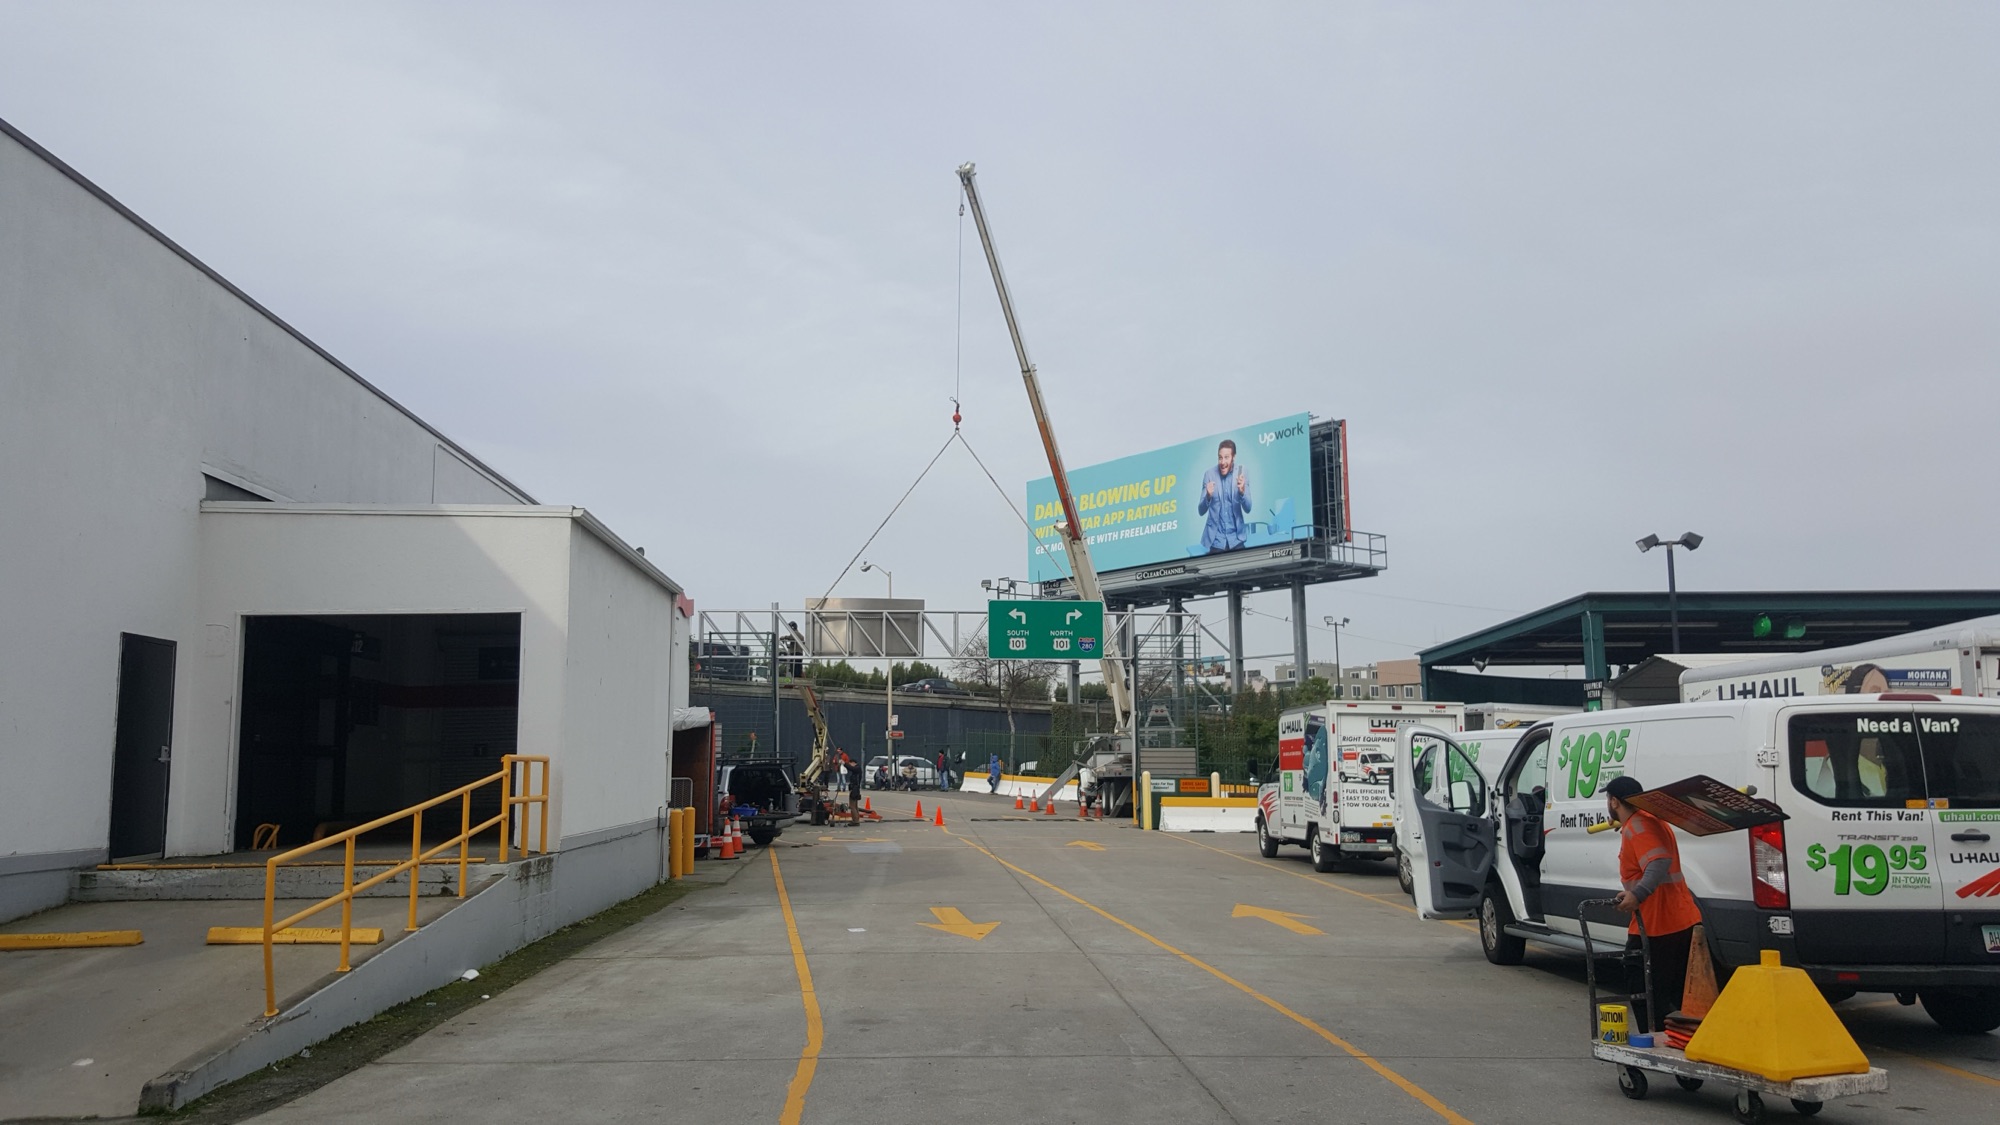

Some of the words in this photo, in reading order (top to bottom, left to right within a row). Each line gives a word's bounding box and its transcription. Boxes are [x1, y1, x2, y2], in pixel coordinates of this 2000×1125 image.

[1035, 497, 1075, 521] DAN
[1080, 480, 1150, 511] BLOWING
[1154, 474, 1176, 495] UP
[1035, 523, 1058, 539] WIT
[1080, 517, 1100, 531] TAR
[1103, 510, 1125, 527] APP
[1126, 500, 1177, 521] RATINGS
[1035, 544, 1049, 555] GET
[1050, 542, 1066, 552] MO
[1097, 531, 1118, 544] WITH
[1119, 520, 1178, 540] FREELANCERS
[1011, 640, 1024, 648] 101
[1055, 640, 1068, 648] 101
[1907, 670, 1947, 680] MONTANA
[1584, 681, 1603, 692] EQUIPMENT
[1587, 689, 1600, 699] RETURN
[1718, 677, 1804, 701] U-HAUL
[1281, 719, 1303, 734] U-HAUL
[1857, 718, 1900, 733] Need
[1902, 721, 1912, 733] a
[1921, 718, 1960, 733] Van?
[1702, 779, 1781, 817] EQUIPMENT
[1706, 787, 1760, 814] RETURN
[1708, 793, 1742, 812] LANE
[1560, 813, 1576, 828] Rent
[1578, 812, 1594, 827] This
[1596, 812, 1609, 825] Va
[1832, 811, 1862, 822] Rent
[1867, 811, 1892, 822] This
[1897, 811, 1924, 822] Van!
[1892, 876, 1931, 884] IN-TOWN
[1600, 1011, 1623, 1023] AUTION
